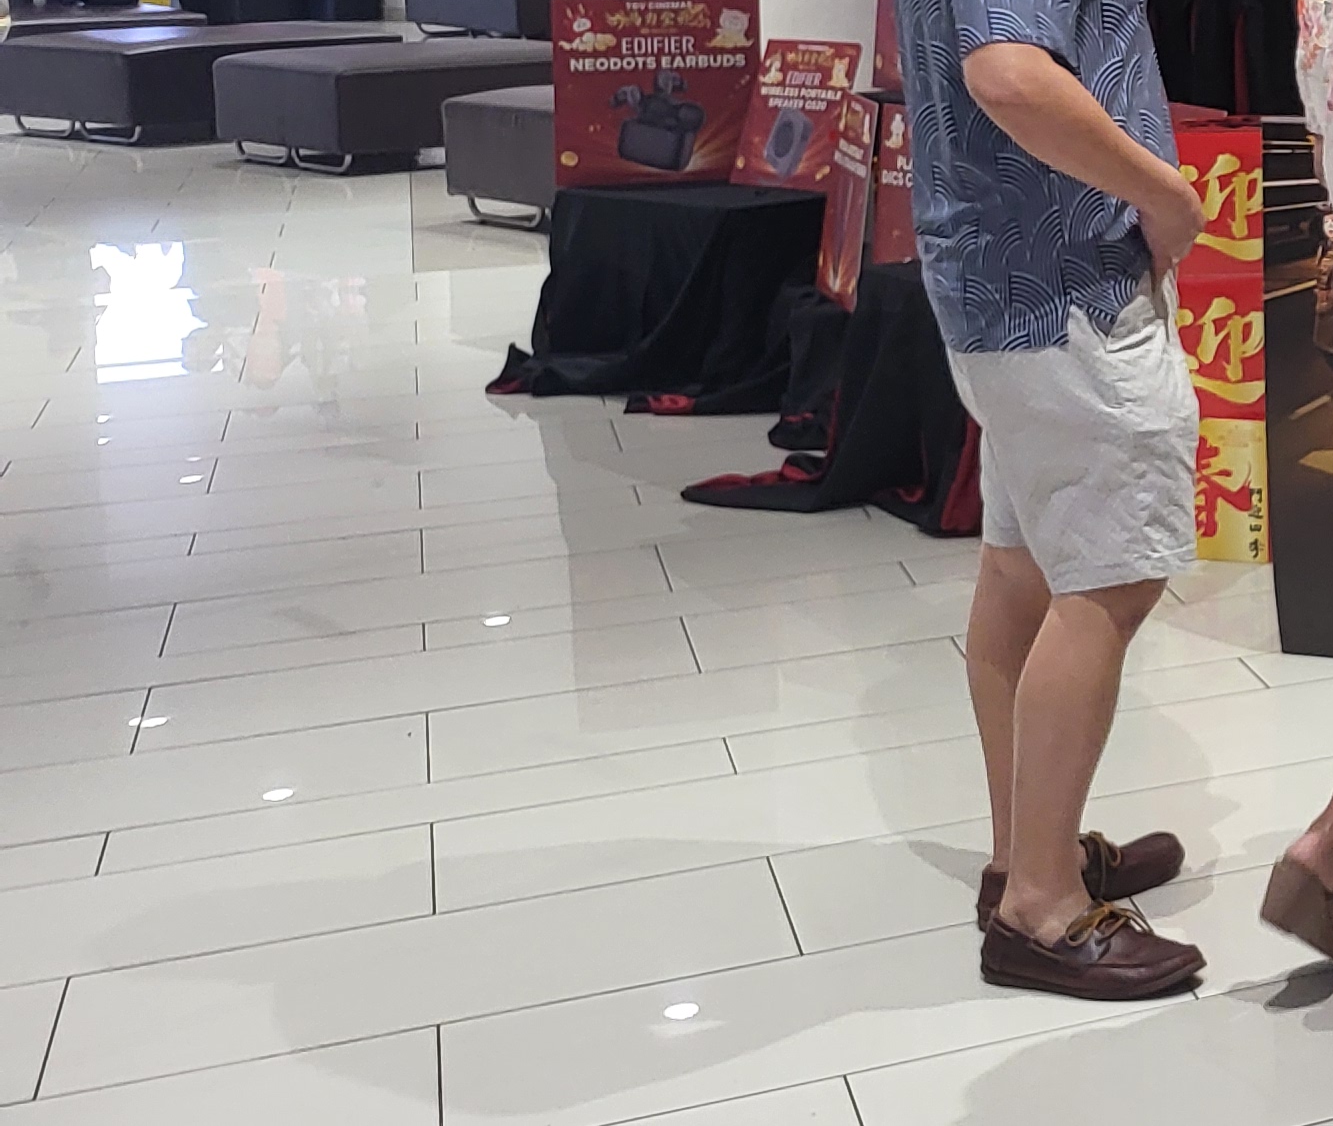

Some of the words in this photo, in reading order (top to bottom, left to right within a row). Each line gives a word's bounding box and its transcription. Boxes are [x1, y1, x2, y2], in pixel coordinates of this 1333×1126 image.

[622, 36, 694, 55] EDIFIER
[570, 56, 657, 72] NEODOTS
[661, 54, 746, 70] EARBUDS
